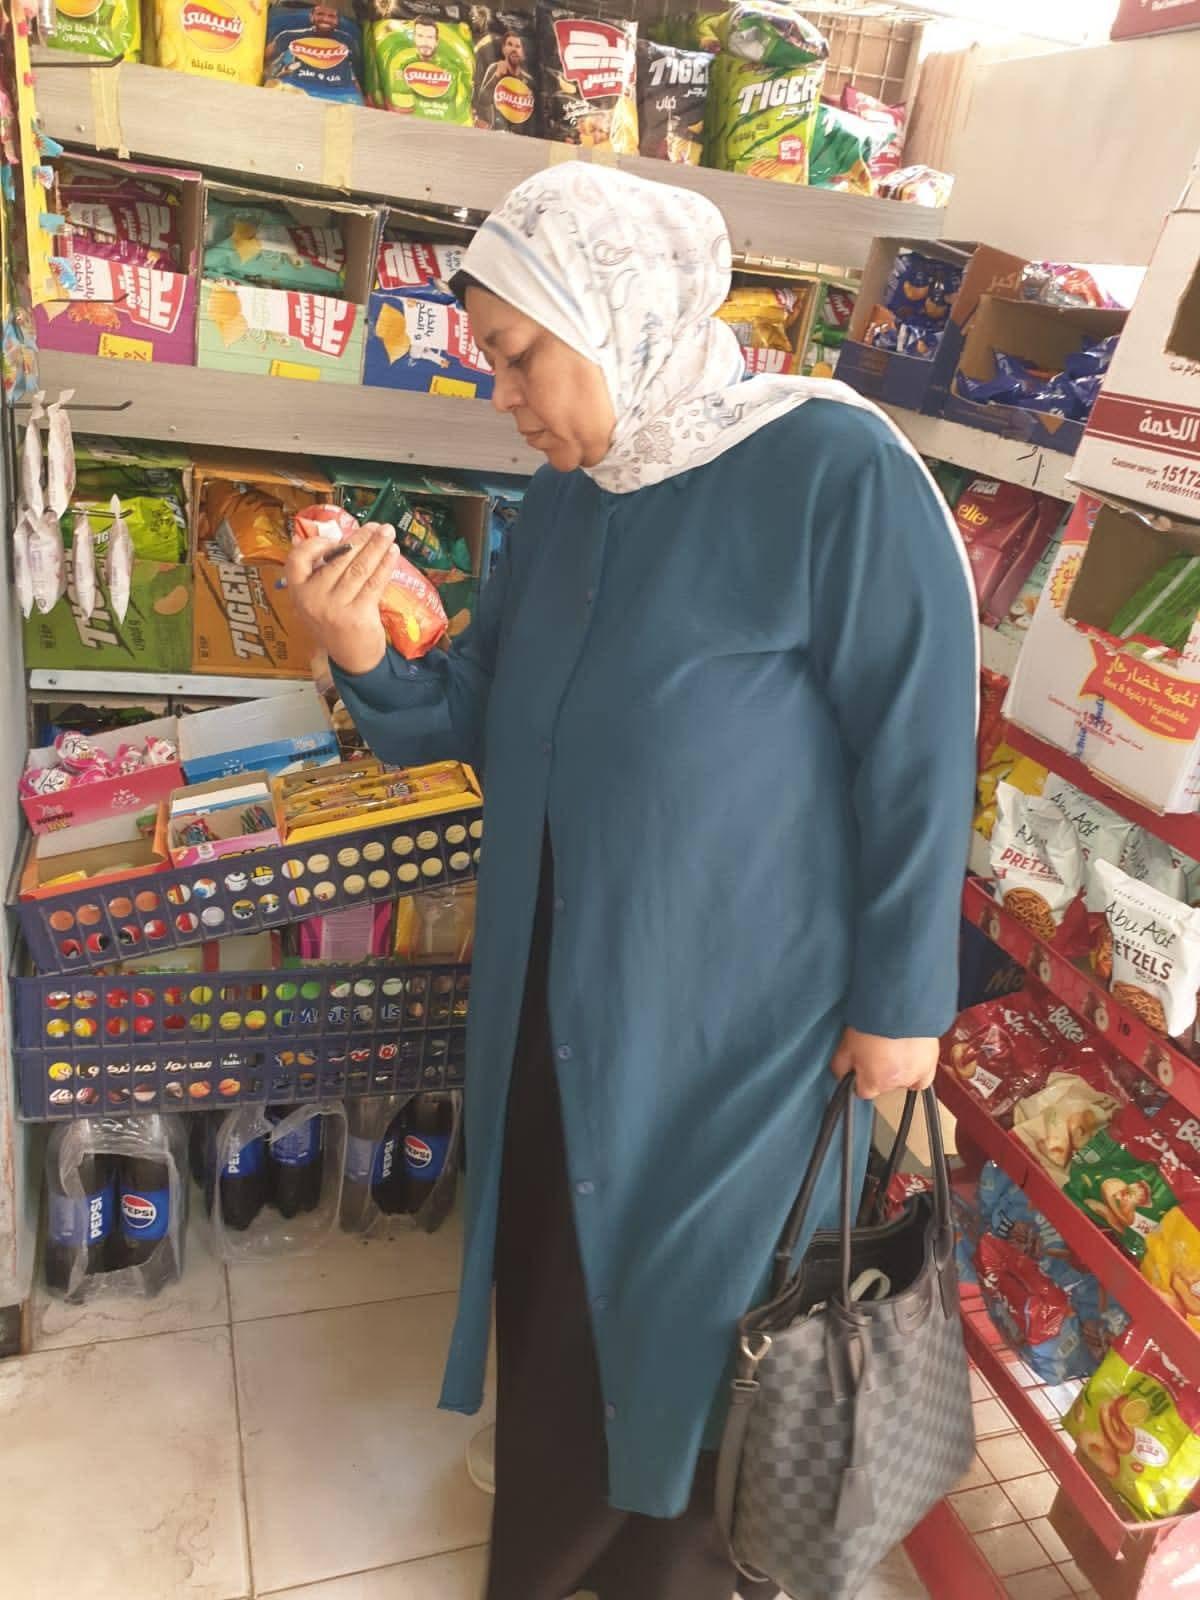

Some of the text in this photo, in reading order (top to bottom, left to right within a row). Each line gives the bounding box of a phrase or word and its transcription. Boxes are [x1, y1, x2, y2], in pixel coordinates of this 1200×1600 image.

[648, 55, 708, 87] TIGE
[738, 74, 820, 115] TIGER
[218, 559, 266, 659] TIGER
[1126, 667, 1161, 693] خضار
[1000, 846, 1058, 876] PRETZ
[1104, 900, 1139, 935] Abu
[1114, 939, 1173, 981] ETZELS
[383, 1140, 394, 1178] PEPSI
[90, 1196, 103, 1239] PEPSI
